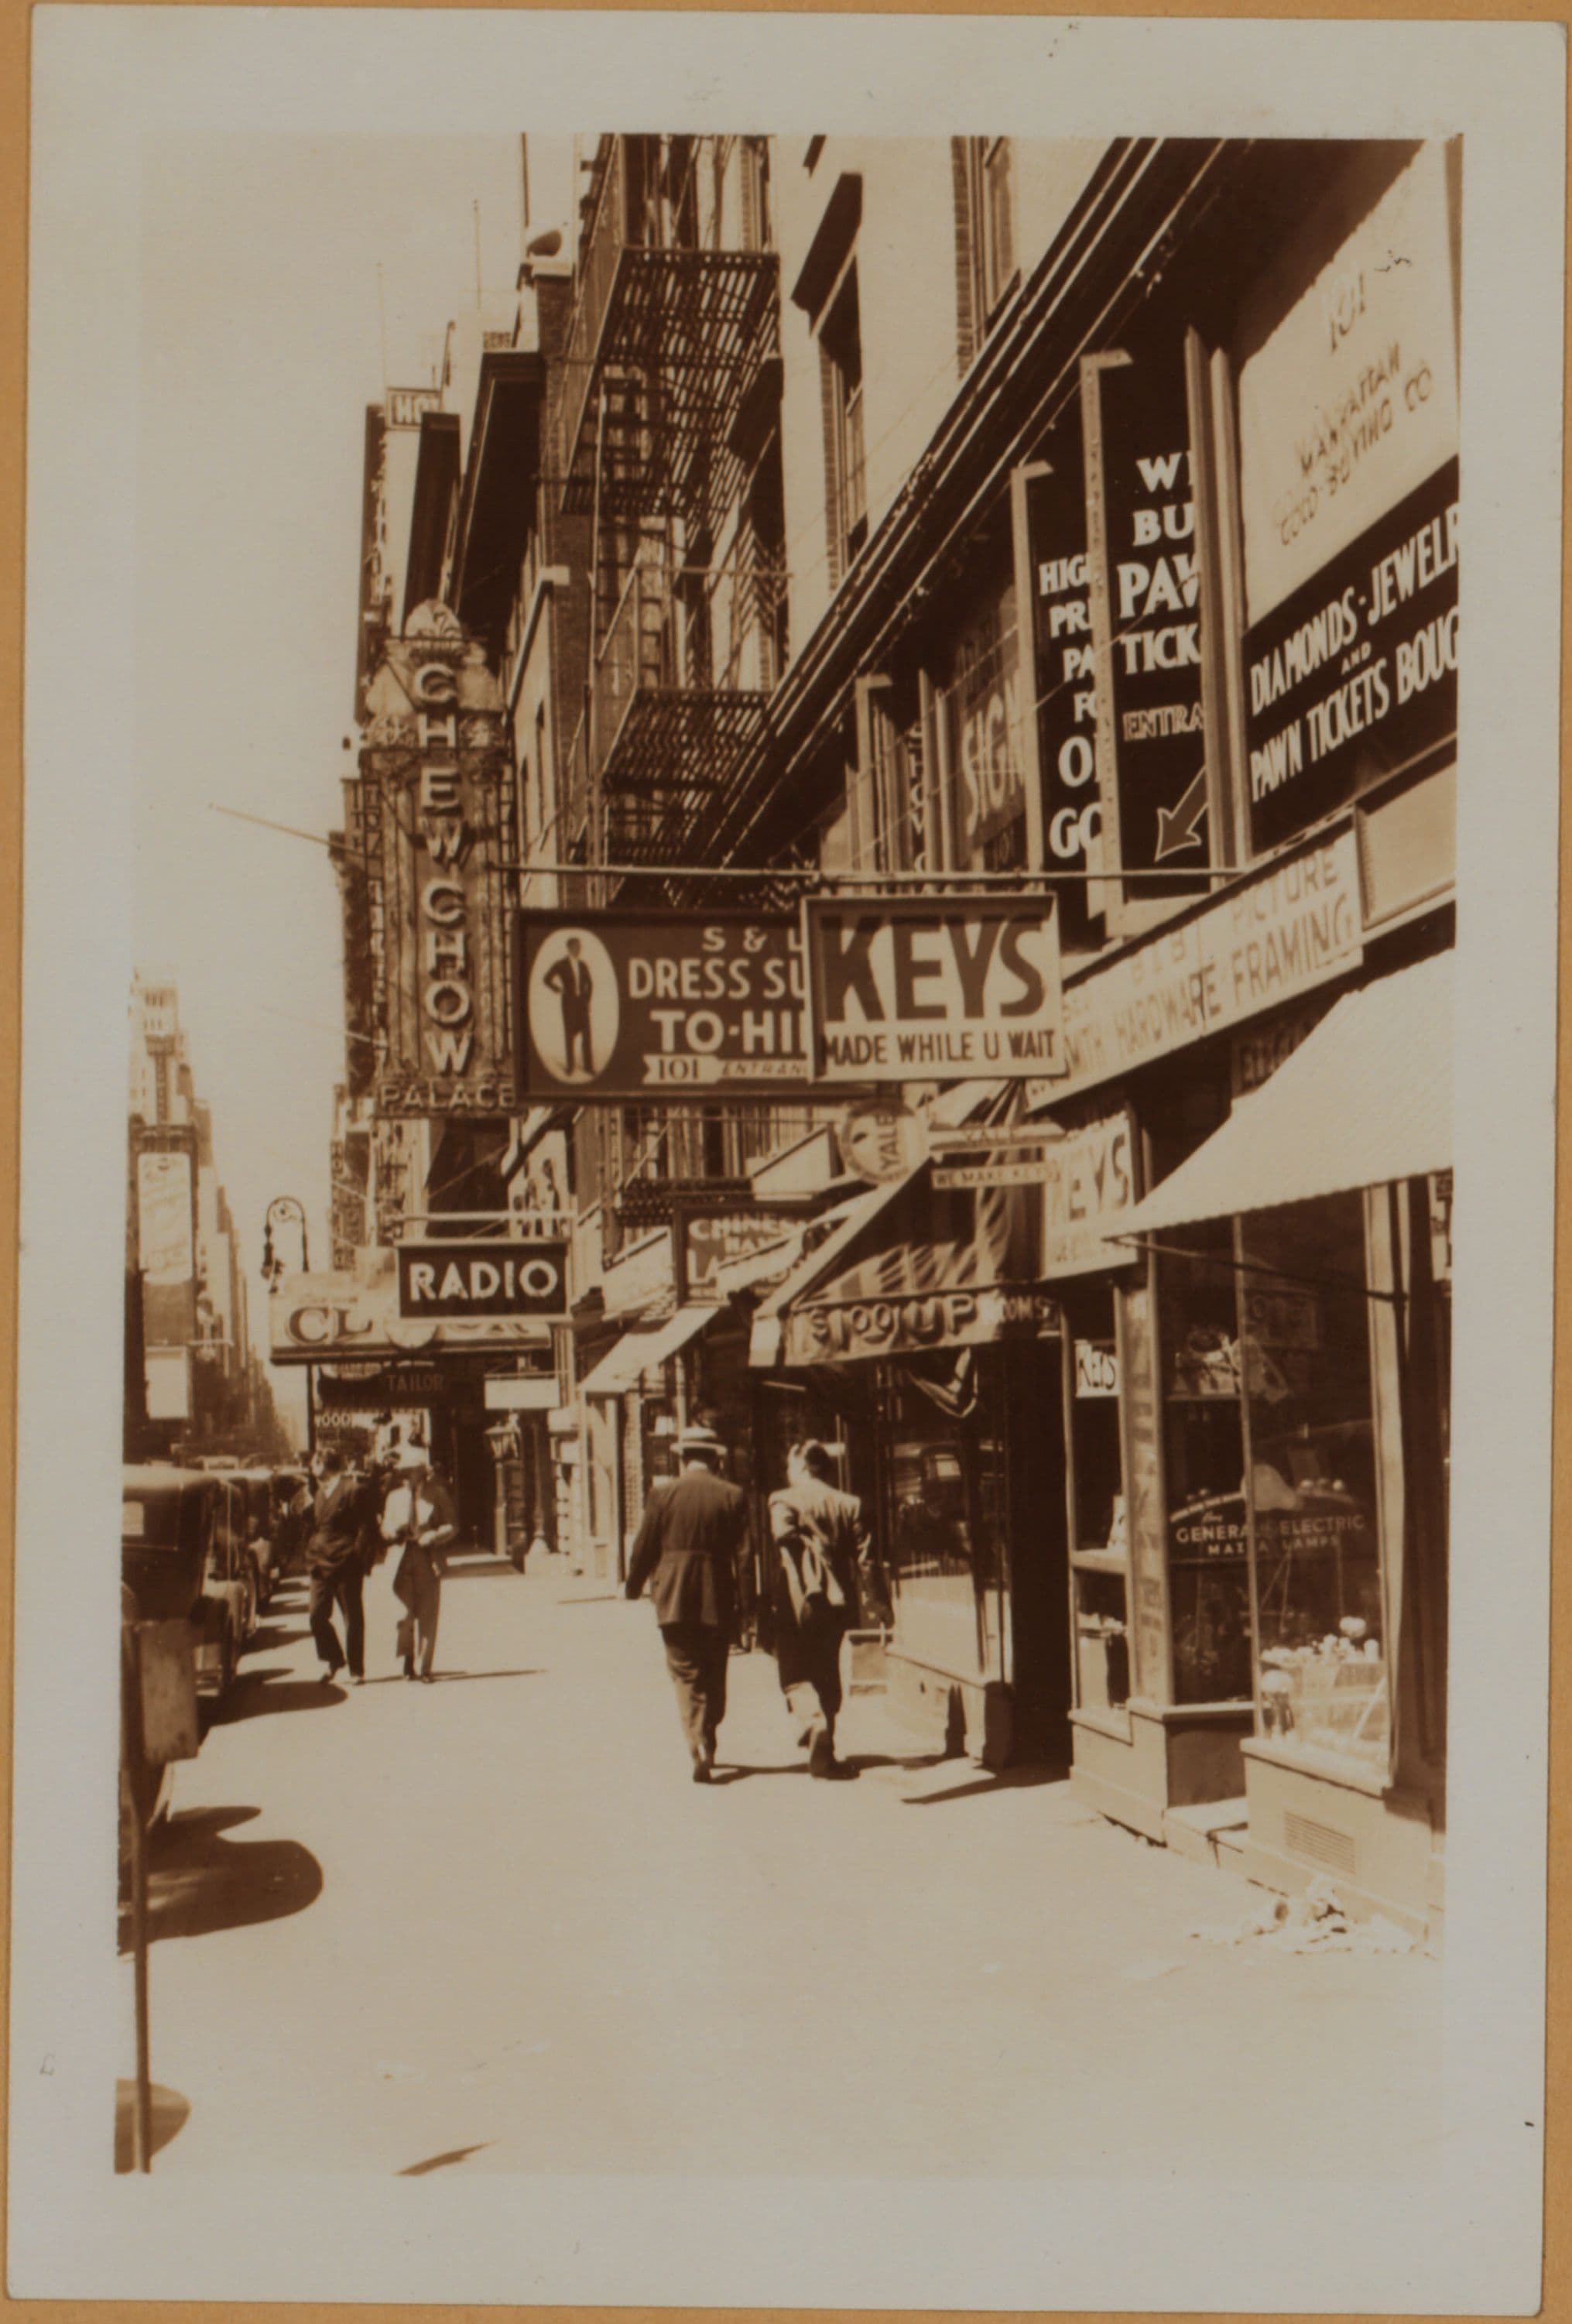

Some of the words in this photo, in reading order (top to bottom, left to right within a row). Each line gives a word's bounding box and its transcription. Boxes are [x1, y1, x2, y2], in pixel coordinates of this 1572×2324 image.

[1341, 641, 1372, 676] AND
[1249, 718, 1303, 803] PAWN
[1306, 657, 1391, 763] TICKETS
[702, 926, 726, 951] S
[743, 926, 766, 952] &
[628, 958, 751, 999] DRESS
[820, 913, 1045, 1022] KEYS
[824, 1033, 888, 1066] MADE
[897, 1032, 973, 1064] WHILE
[984, 1031, 999, 1061] U
[1008, 1029, 1054, 1060] WAIT
[380, 1080, 515, 1109] PALACE
[409, 1259, 558, 1301] RADIO
[388, 1373, 445, 1393] TAILOR
[1279, 1514, 1365, 1535] ELECTRIC
[1281, 1535, 1341, 1551] LAMPS
